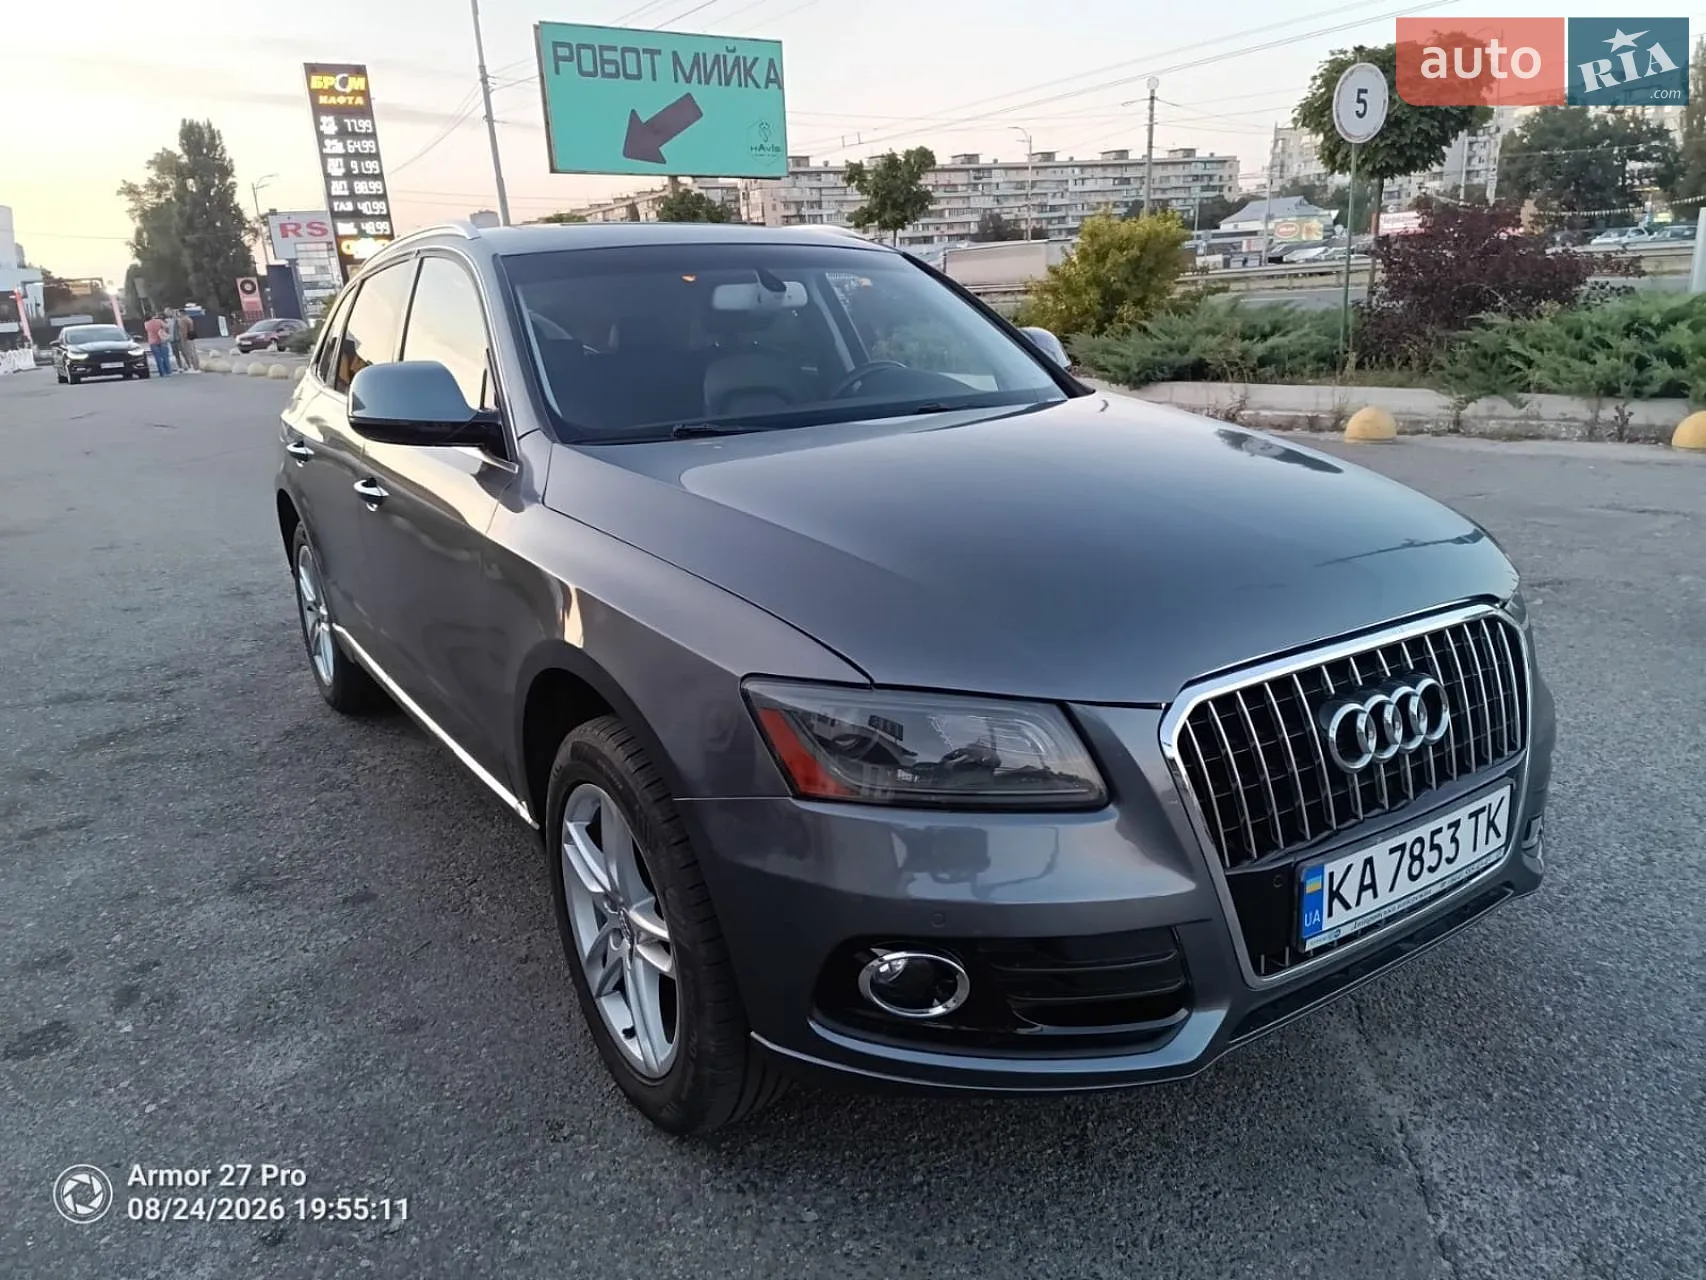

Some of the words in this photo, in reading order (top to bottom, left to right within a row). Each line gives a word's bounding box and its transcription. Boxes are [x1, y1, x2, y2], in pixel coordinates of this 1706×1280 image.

[551, 40, 662, 82] РОБОТ
[671, 46, 783, 90] МИЙКА
[318, 95, 365, 105] НАФТА
[1355, 88, 1369, 119] 5
[333, 201, 354, 211] ГАЗ
[279, 221, 329, 239] RS
[1327, 855, 1379, 919] KA
[1388, 818, 1462, 892] 7853
[1467, 796, 1505, 852] TK
[1304, 909, 1321, 928] UA
